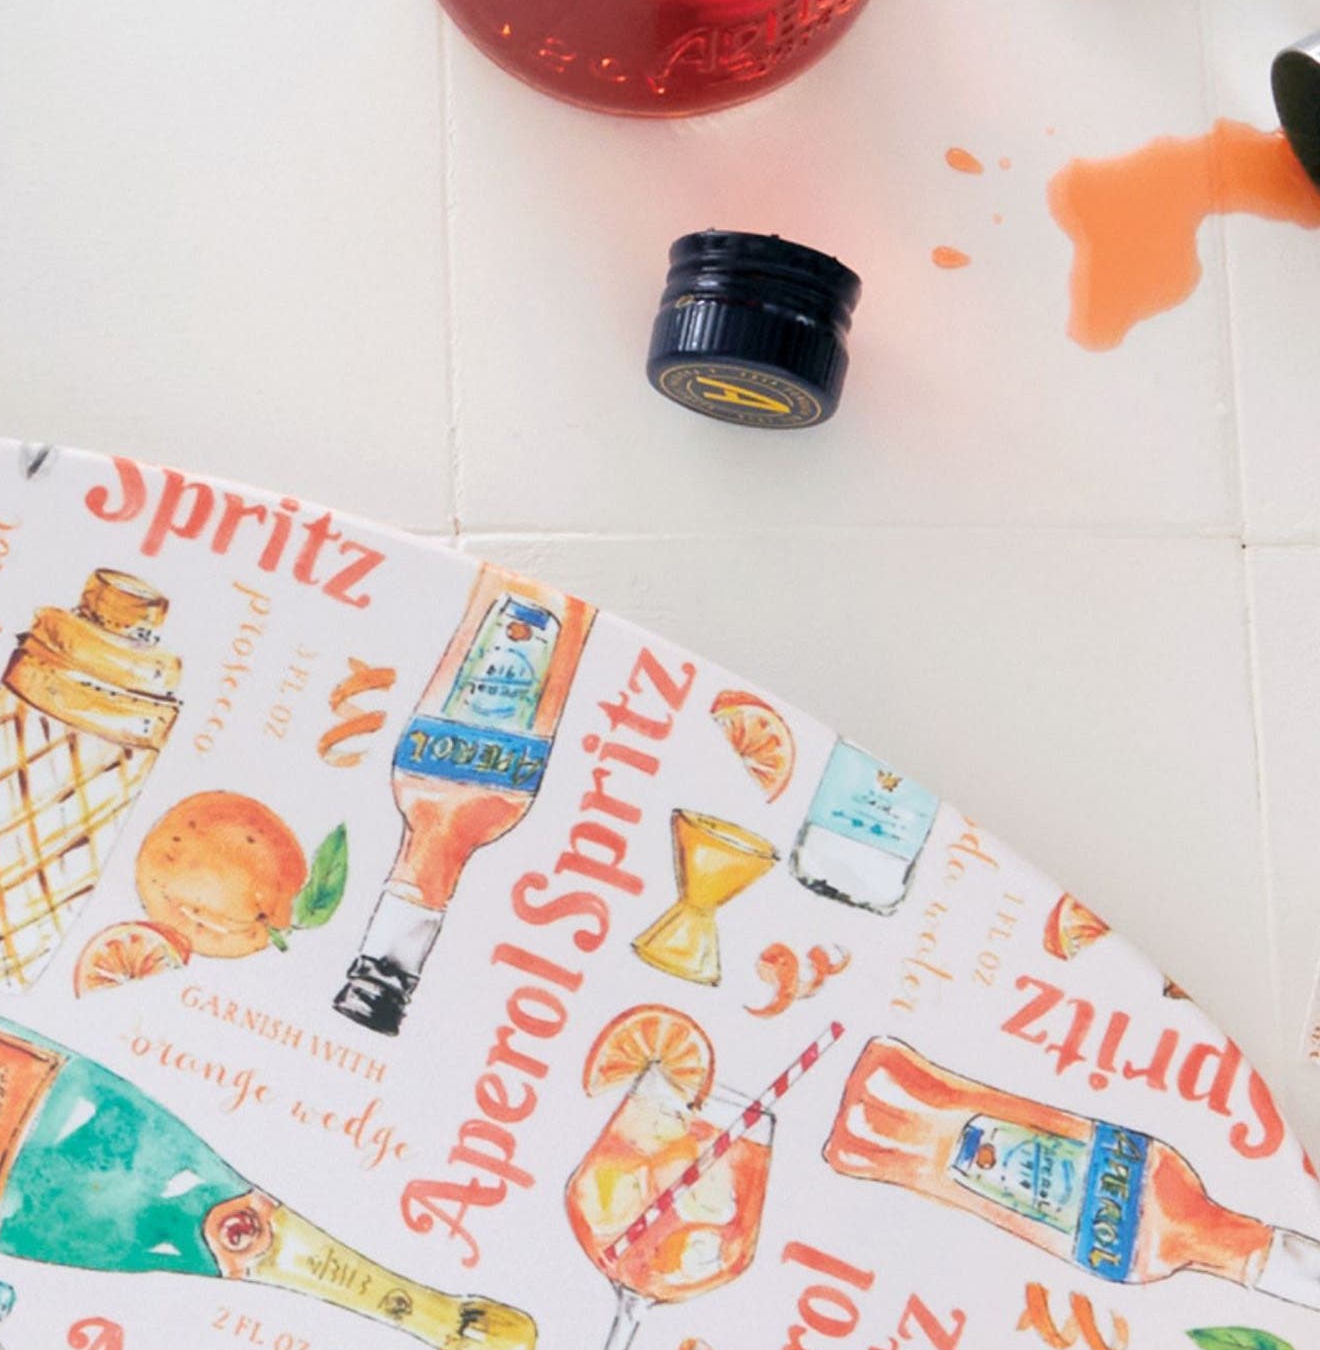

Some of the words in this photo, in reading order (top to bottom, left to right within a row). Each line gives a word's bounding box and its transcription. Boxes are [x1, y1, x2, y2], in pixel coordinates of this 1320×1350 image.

[180, 983, 303, 1050] GARNISH
[309, 1034, 388, 1084] WITH
[400, 942, 585, 1269] Aperol
[511, 646, 697, 953] Spritz
[130, 1032, 276, 1112] orange
[290, 1097, 418, 1170] wedge
[1001, 974, 1284, 1159] Spritz
